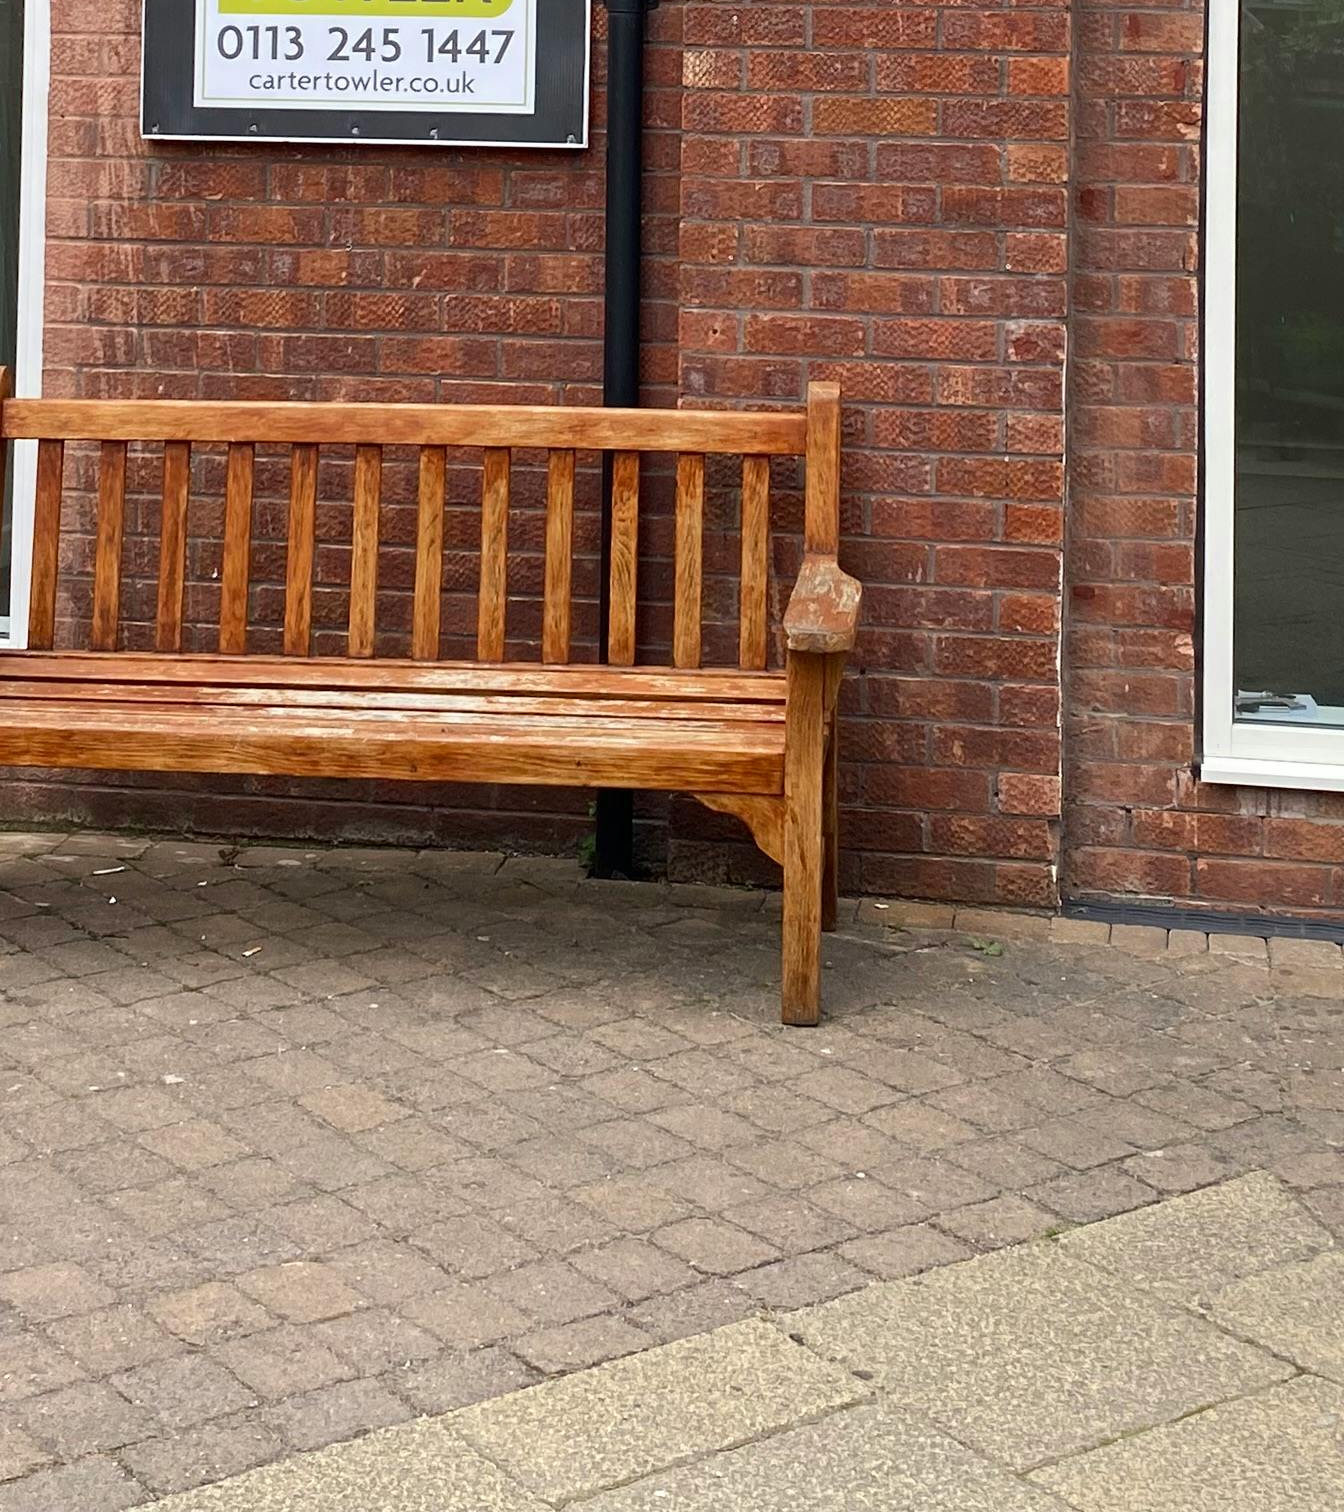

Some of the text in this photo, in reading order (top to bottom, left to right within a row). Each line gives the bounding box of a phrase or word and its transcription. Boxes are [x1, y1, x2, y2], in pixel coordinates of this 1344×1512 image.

[217, 25, 515, 64] 0113 245 1447
[249, 69, 475, 94] cartertowler.co.uk
